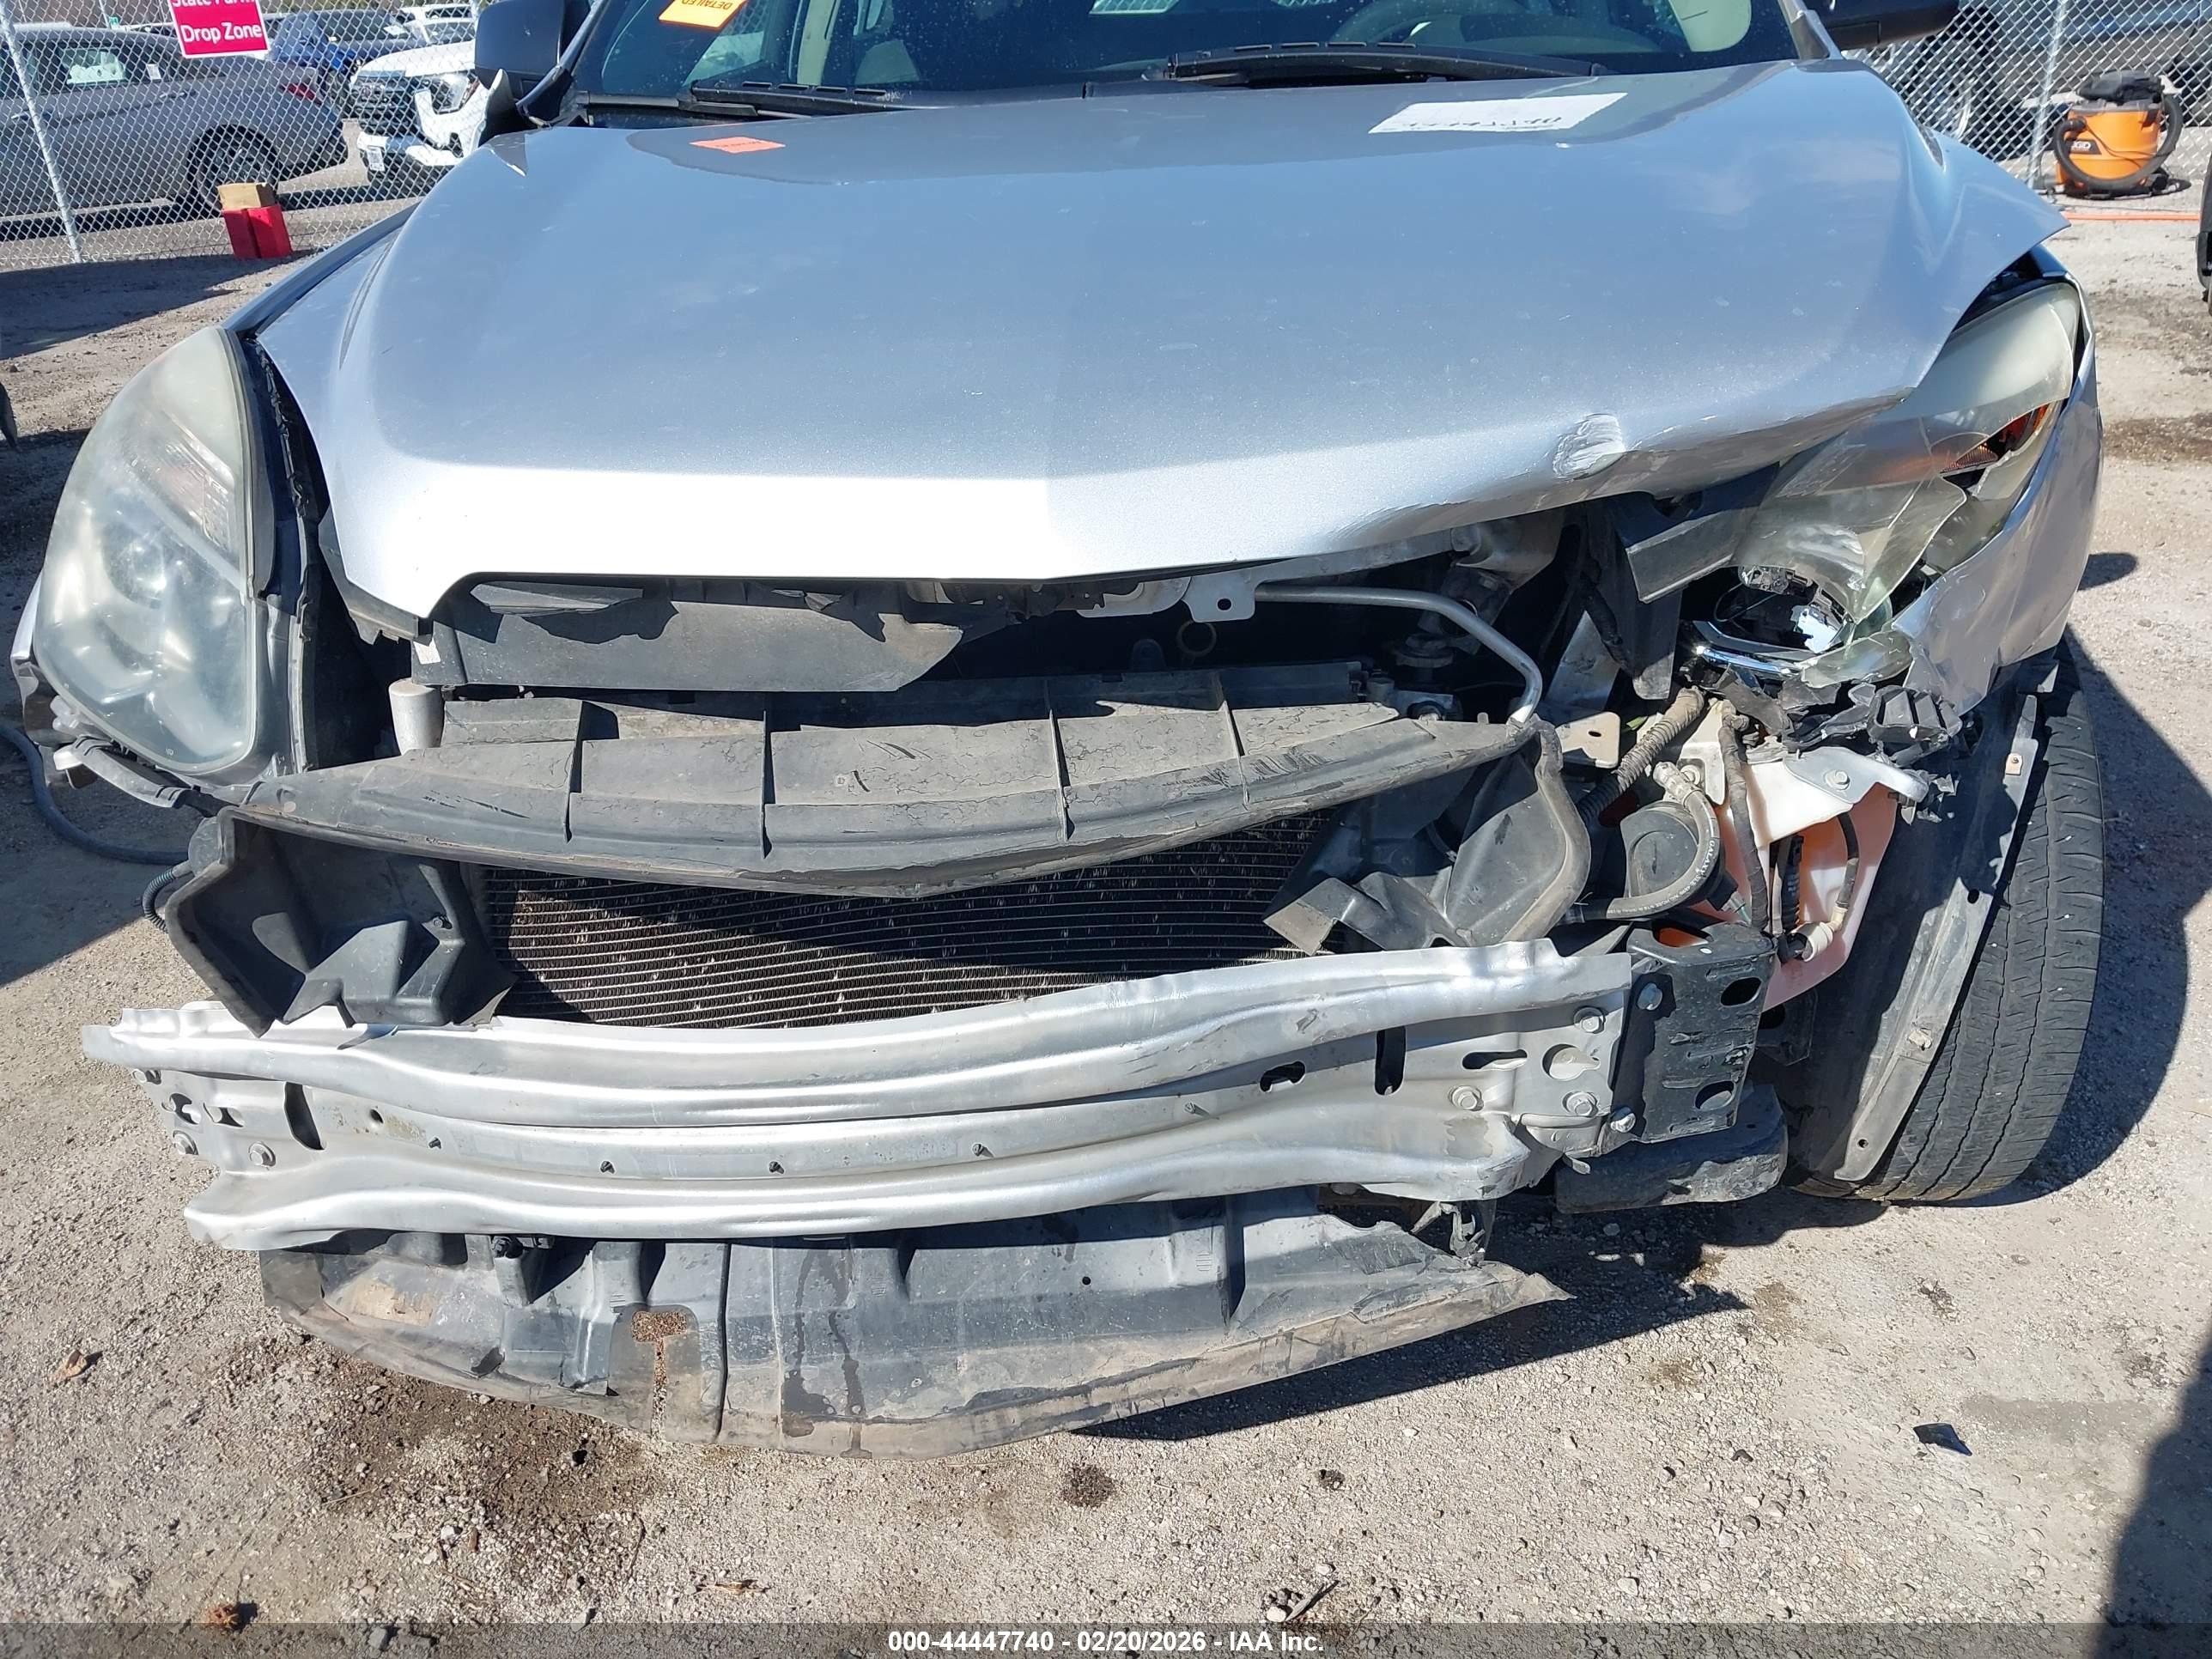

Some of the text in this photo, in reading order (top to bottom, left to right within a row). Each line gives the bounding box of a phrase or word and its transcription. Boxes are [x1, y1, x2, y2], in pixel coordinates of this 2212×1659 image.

[180, 21, 262, 44] Drop Zone
[1699, 840, 1716, 875] GALAXY
